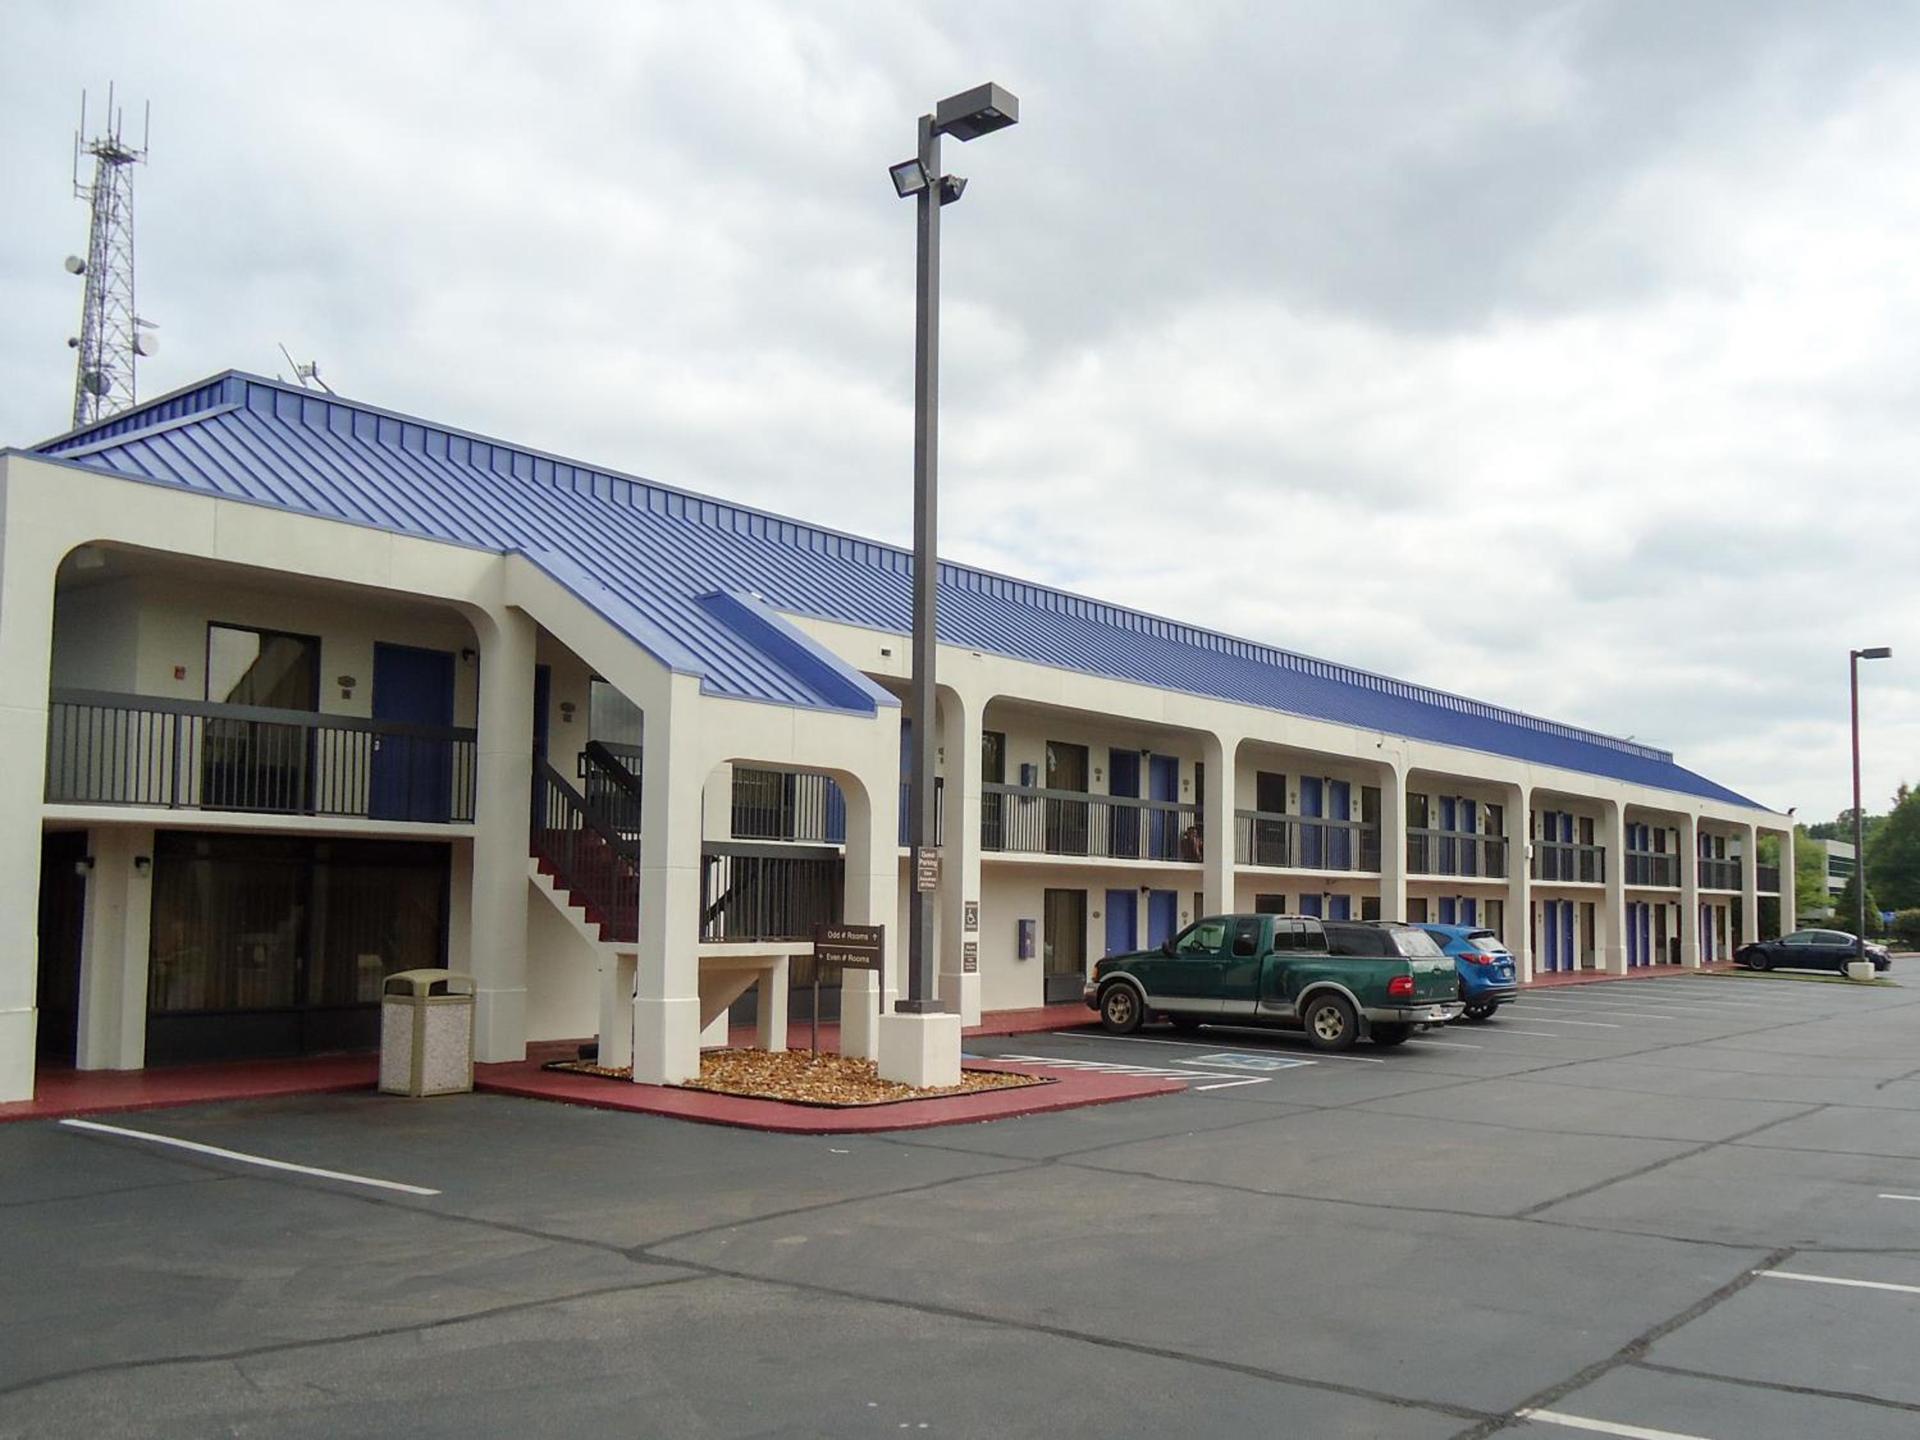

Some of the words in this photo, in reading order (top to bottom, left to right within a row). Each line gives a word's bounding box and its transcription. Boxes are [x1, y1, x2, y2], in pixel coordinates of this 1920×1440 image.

[919, 860, 938, 868] Parking
[828, 930, 840, 939] Odd
[847, 932, 868, 940] Rooms
[826, 953, 841, 961] Even
[848, 954, 870, 963] Rooms
